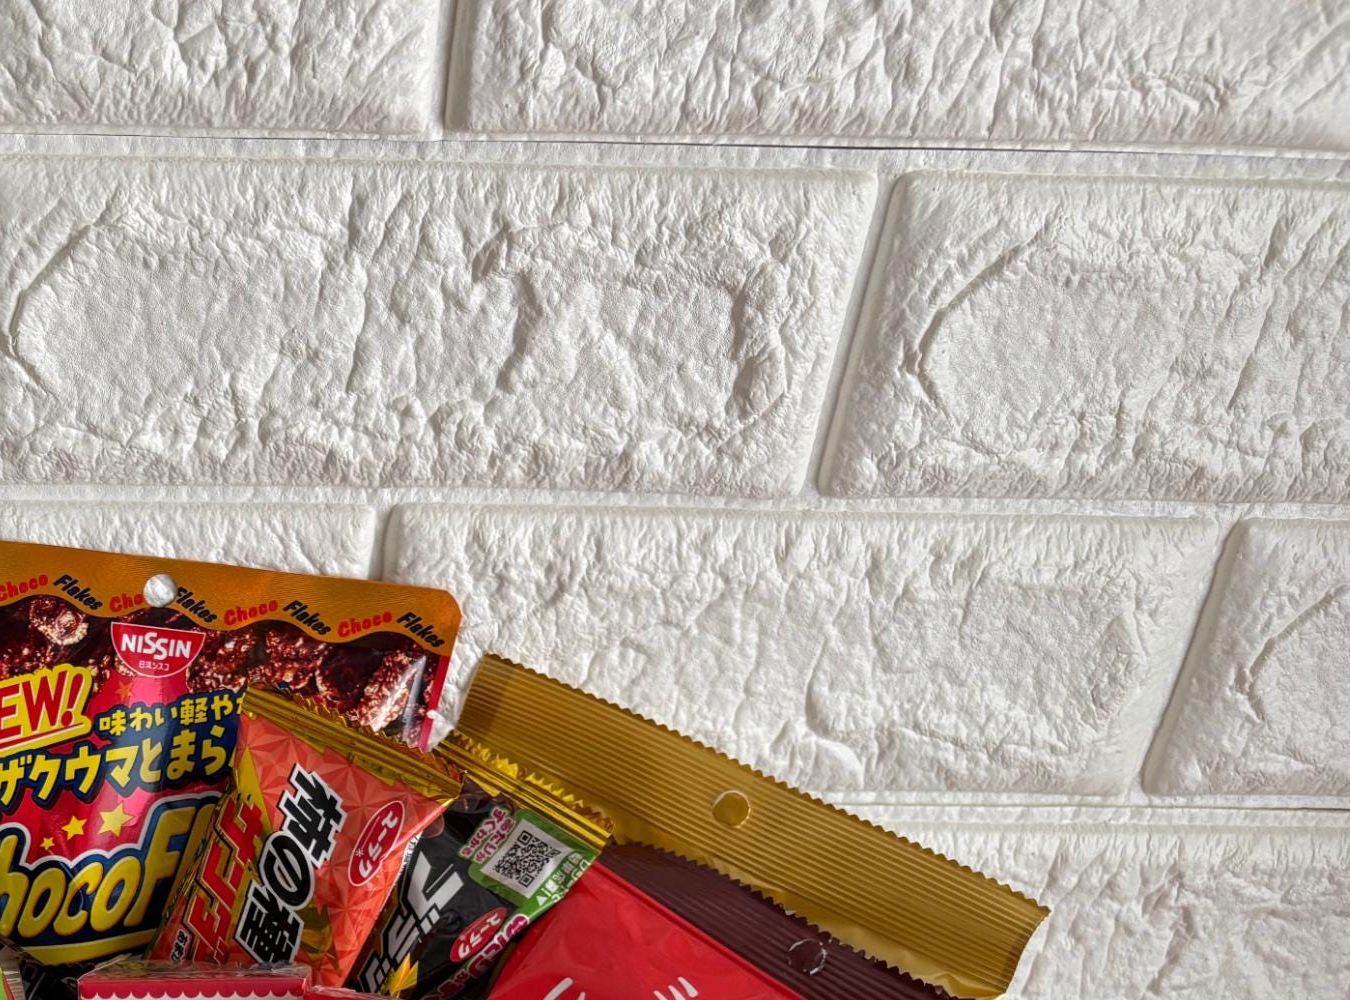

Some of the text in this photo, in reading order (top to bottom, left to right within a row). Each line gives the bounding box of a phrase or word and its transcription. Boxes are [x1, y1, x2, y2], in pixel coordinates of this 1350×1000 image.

[53, 573, 103, 612] Flakes
[224, 600, 279, 625] Choco
[283, 600, 332, 636] Flakes
[337, 611, 393, 638] Choco
[396, 611, 445, 649] Flakes
[121, 632, 192, 660] NISSIN
[241, 768, 345, 962] 柿の種
